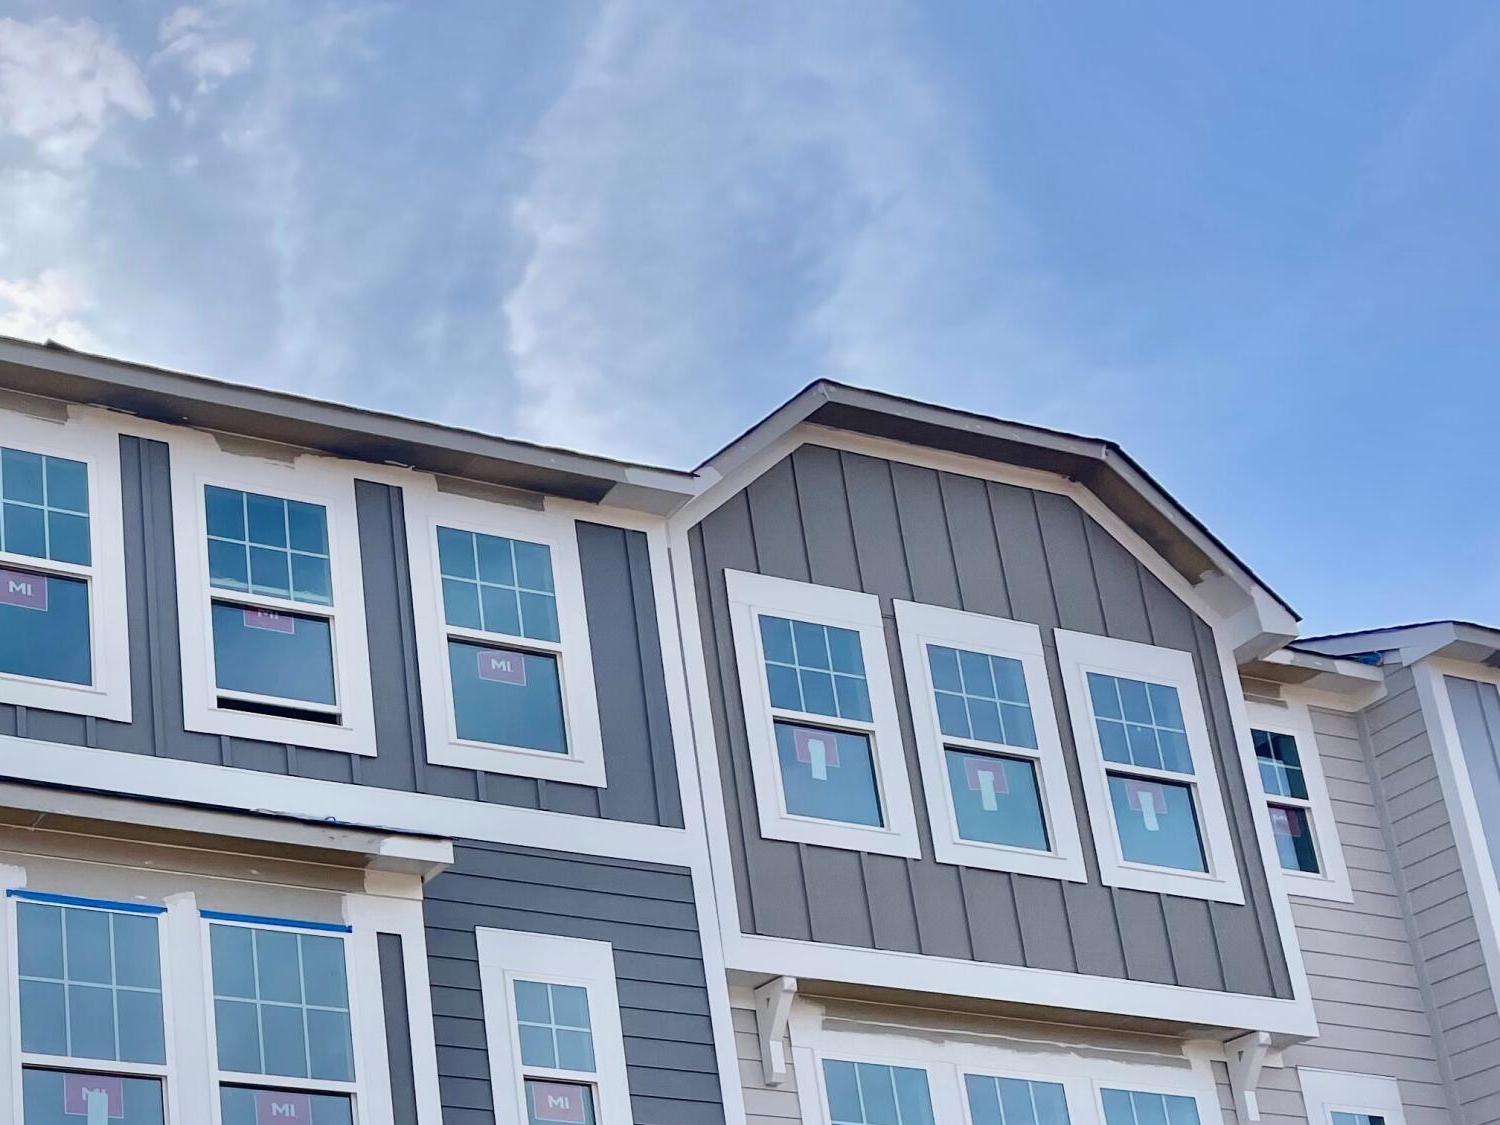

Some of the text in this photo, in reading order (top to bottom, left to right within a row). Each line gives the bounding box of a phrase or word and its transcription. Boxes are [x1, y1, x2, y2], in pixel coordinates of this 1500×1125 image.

[8, 580, 32, 596] MI
[491, 658, 512, 673] MI
[271, 1102, 296, 1117] MI
[547, 1095, 570, 1110] MI
